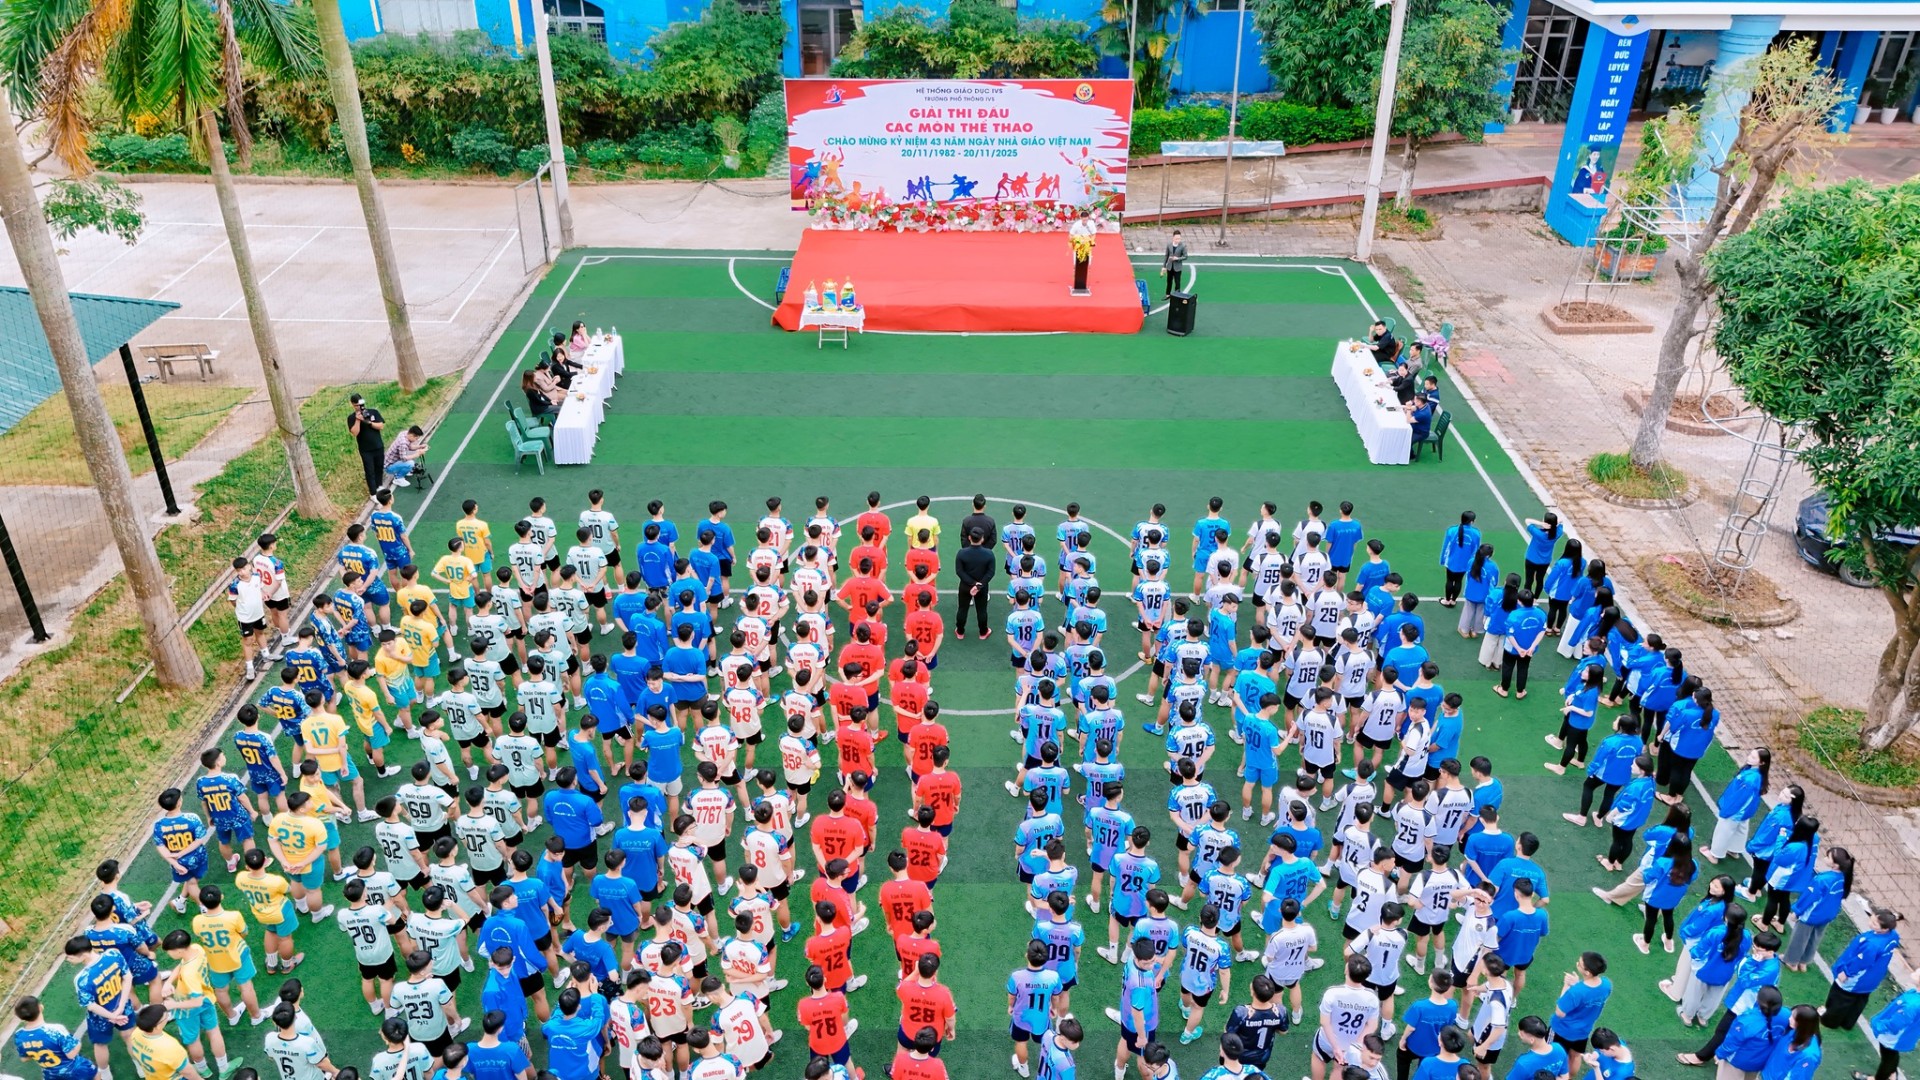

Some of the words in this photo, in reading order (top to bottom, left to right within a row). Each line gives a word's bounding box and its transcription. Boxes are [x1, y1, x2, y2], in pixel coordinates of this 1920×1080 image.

[909, 106, 941, 118] GIẢI
[947, 108, 972, 118] THI
[978, 105, 1009, 118] ĐẤU
[919, 120, 955, 133] MÔN
[960, 119, 987, 133] THỂ
[993, 123, 1033, 133] THAO
[828, 136, 856, 146] CHÀO
[859, 136, 888, 146] MỪNG
[890, 135, 902, 146] KỶ
[905, 136, 927, 148] NIỆM
[930, 138, 941, 146] 43
[944, 136, 964, 146] NĂM
[968, 136, 995, 146] NGÀY
[998, 136, 1018, 146] NHÀ
[1021, 136, 1046, 146] GIÁO
[1048, 136, 1067, 148] VIỆT
[1069, 138, 1091, 146] NAM
[901, 149, 956, 158] 20/11/1982
[963, 149, 1018, 158] 20/11/2025
[463, 531, 477, 544] 15
[578, 561, 591, 576] 11
[1320, 608, 1338, 623] 29
[1018, 627, 1032, 641] 18
[470, 675, 489, 691] 33
[1298, 668, 1316, 683] 08
[274, 704, 296, 720] 28
[528, 698, 545, 715] 14
[732, 708, 751, 723] 48
[312, 728, 329, 746] 17
[1037, 724, 1050, 738] 11
[241, 748, 262, 765] 91
[1183, 741, 1204, 757] 49
[511, 751, 522, 767] 9
[931, 793, 950, 809] 24
[408, 802, 432, 818] 69
[697, 806, 722, 824] 7767
[1186, 802, 1203, 820] 10
[1442, 809, 1463, 829] 17
[277, 828, 305, 848] 23
[466, 834, 486, 851] 07
[1398, 823, 1417, 845] 25
[824, 837, 846, 855] 57
[755, 850, 766, 868] 8
[910, 849, 931, 866] 22
[1122, 874, 1144, 892] 29
[1286, 876, 1307, 896] 28
[1214, 890, 1235, 912] 35
[1357, 891, 1369, 912] 3
[1433, 892, 1449, 910] 15
[200, 930, 230, 948] 36
[1048, 944, 1070, 961] 09
[1190, 948, 1208, 972] 16
[825, 952, 843, 971] 12
[405, 1001, 434, 1019] 23
[650, 997, 676, 1016] 23
[1028, 993, 1045, 1012] 11
[909, 1007, 935, 1023] 28
[1338, 1012, 1365, 1029] 28
[1257, 1027, 1268, 1049] 1
[281, 1057, 295, 1075] 6
